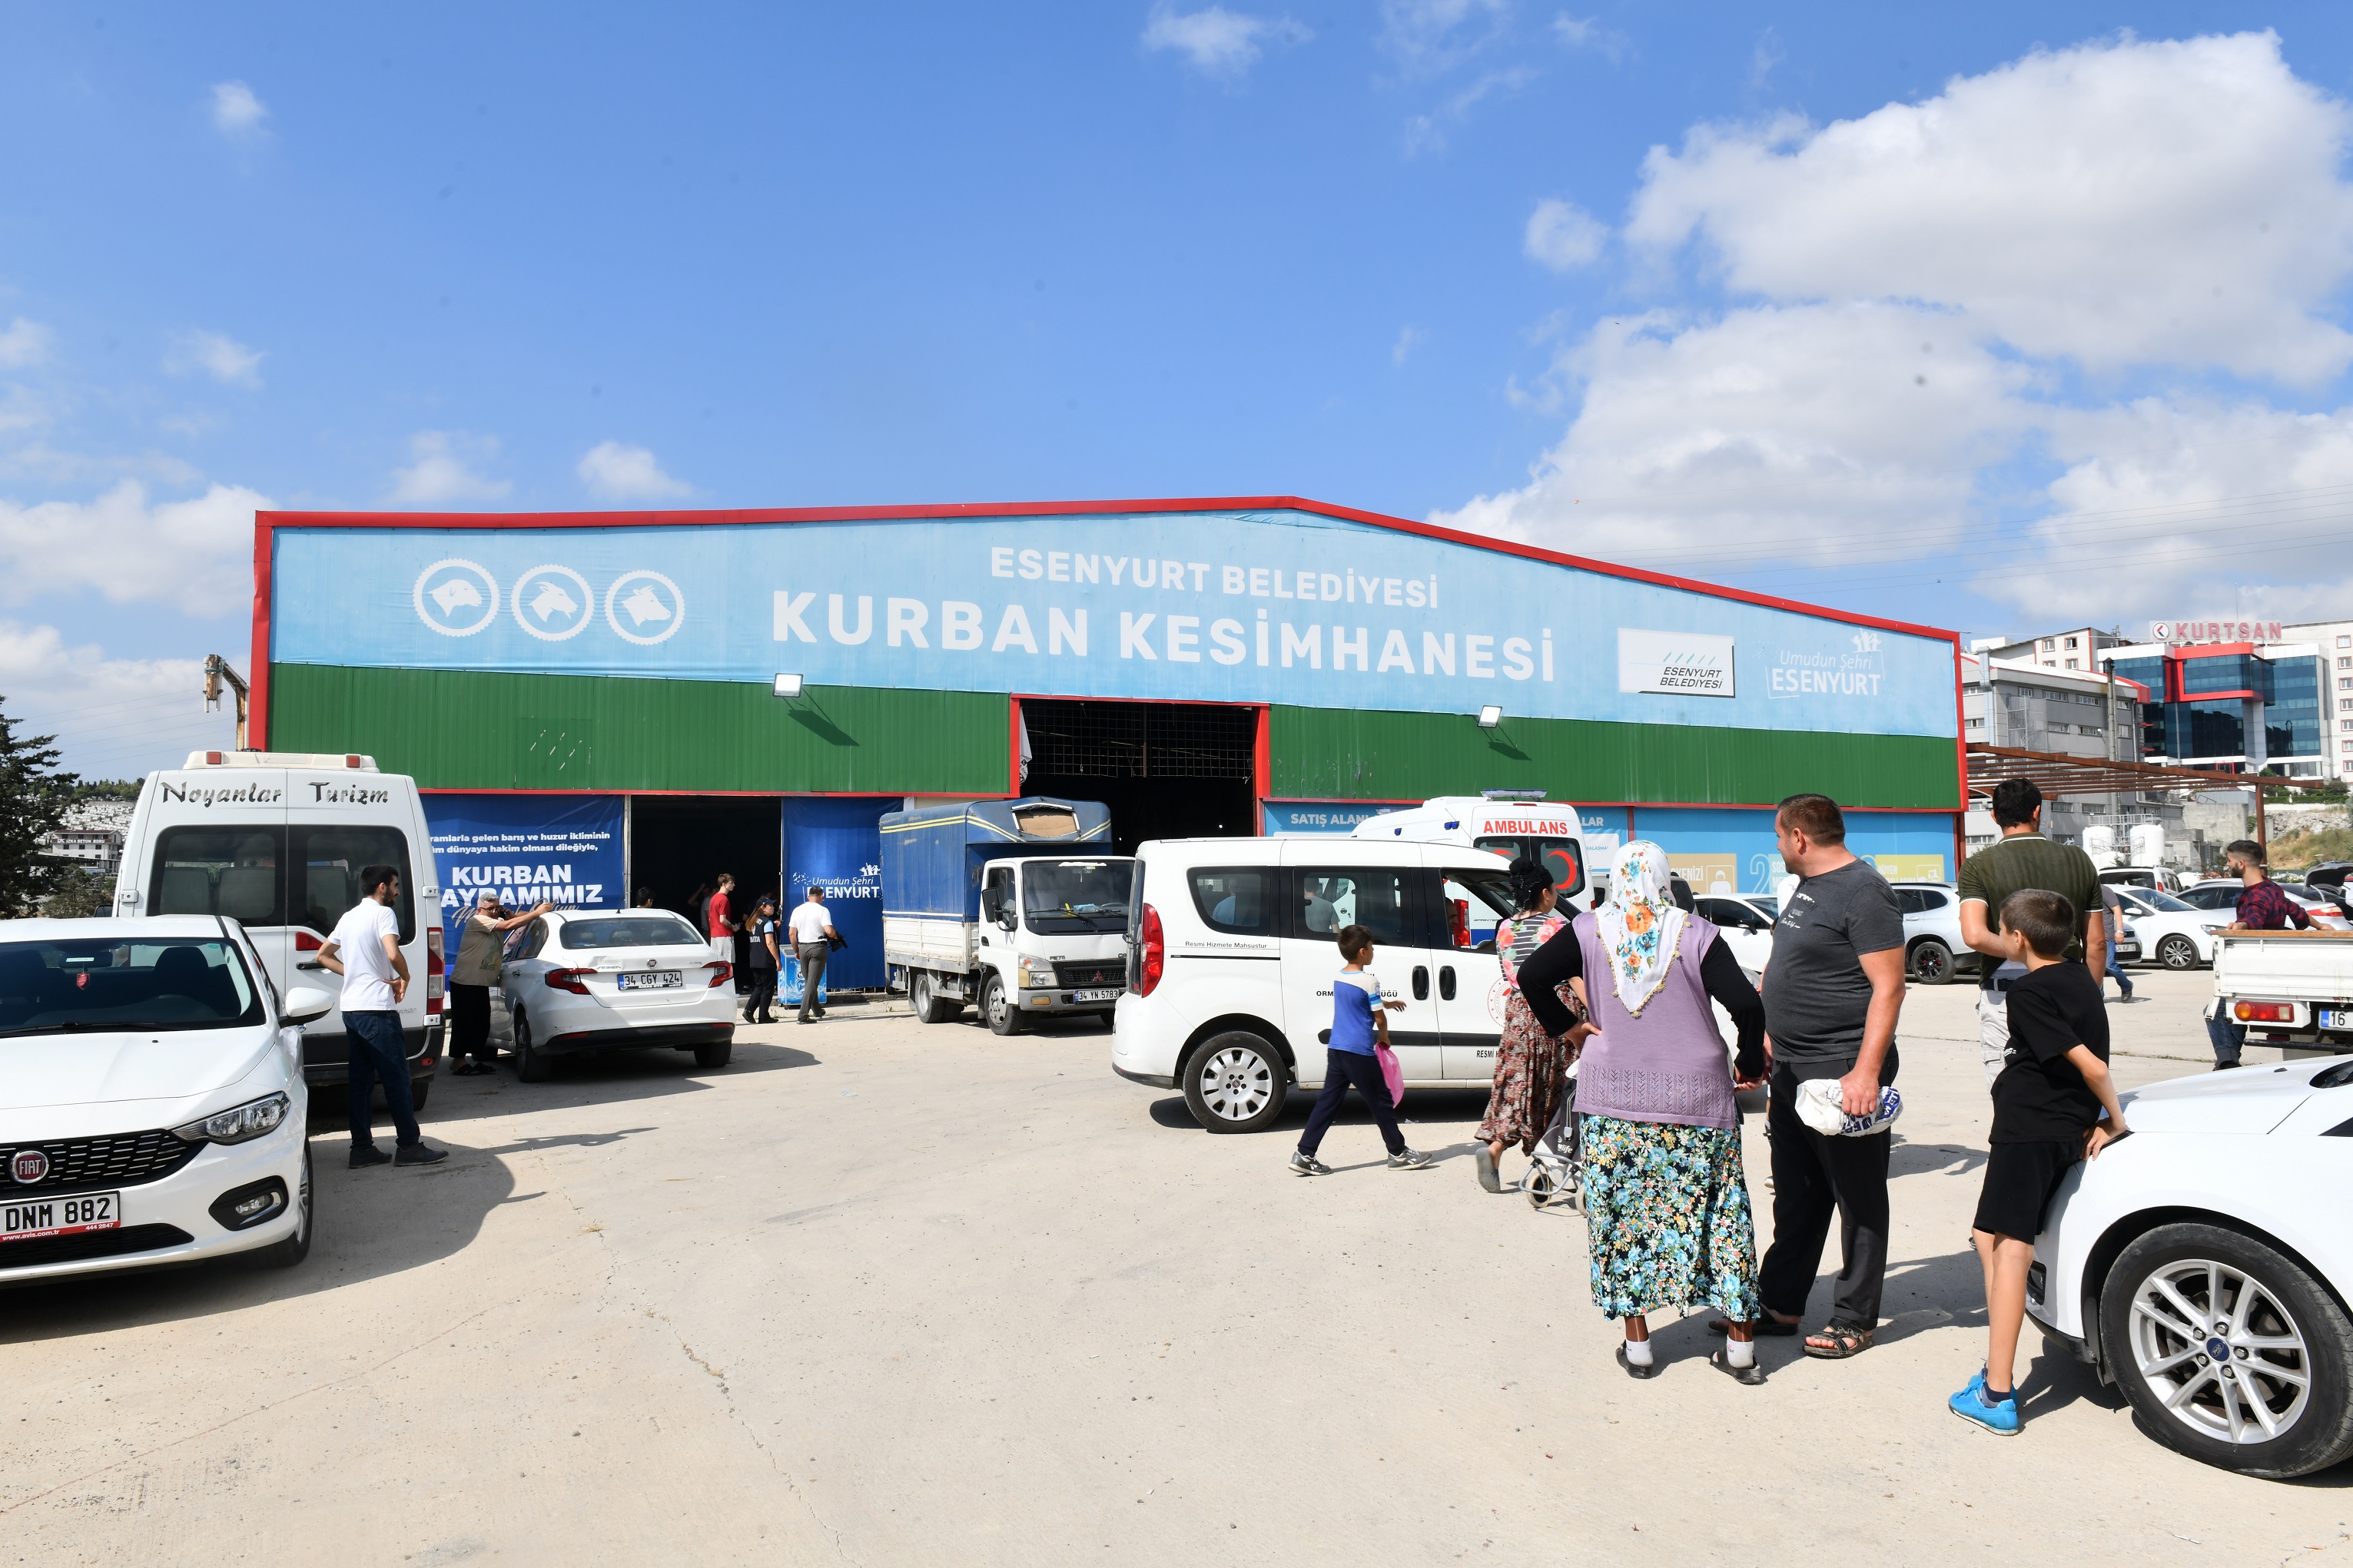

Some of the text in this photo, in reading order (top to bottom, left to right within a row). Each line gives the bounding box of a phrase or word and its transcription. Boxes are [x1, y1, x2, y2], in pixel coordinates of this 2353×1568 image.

[991, 546, 1439, 608] ESENYURT BELEDİYESİ
[774, 591, 1554, 682] KURBAN KESİMHANESİ
[2175, 622, 2282, 639] KURTSAN
[1780, 650, 1872, 671] Umudun Şehri
[1664, 667, 1722, 678] ESENYURT
[1660, 677, 1723, 688] BELEDİYESİ
[1772, 668, 1881, 696] ESENYURT
[160, 781, 388, 807] Noyanlar Turizm
[1291, 814, 1327, 827] SATIŞ
[1580, 817, 1604, 827] LAR
[1483, 820, 1568, 835] AMBULANS
[472, 834, 499, 843] gelen
[501, 834, 525, 843] barış
[569, 831, 610, 840] ikliminin
[446, 846, 488, 854] dünyaya
[556, 843, 598, 852] dileğiyle,
[452, 864, 572, 886] KURBAN
[812, 877, 874, 887] Umudun Şehri
[807, 886, 880, 899] ENYURT
[625, 976, 636, 985] 34
[641, 974, 657, 984] CGY
[663, 973, 679, 983] 424
[1079, 992, 1087, 1000] 34
[1101, 990, 1118, 999] 5783
[2331, 1012, 2345, 1026] 16
[1476, 1048, 1495, 1058] RESMİ
[19, 1159, 41, 1175] FIAT
[5, 1197, 110, 1232] DNM 882
[2, 1229, 60, 1241] www.avis.com.tr
